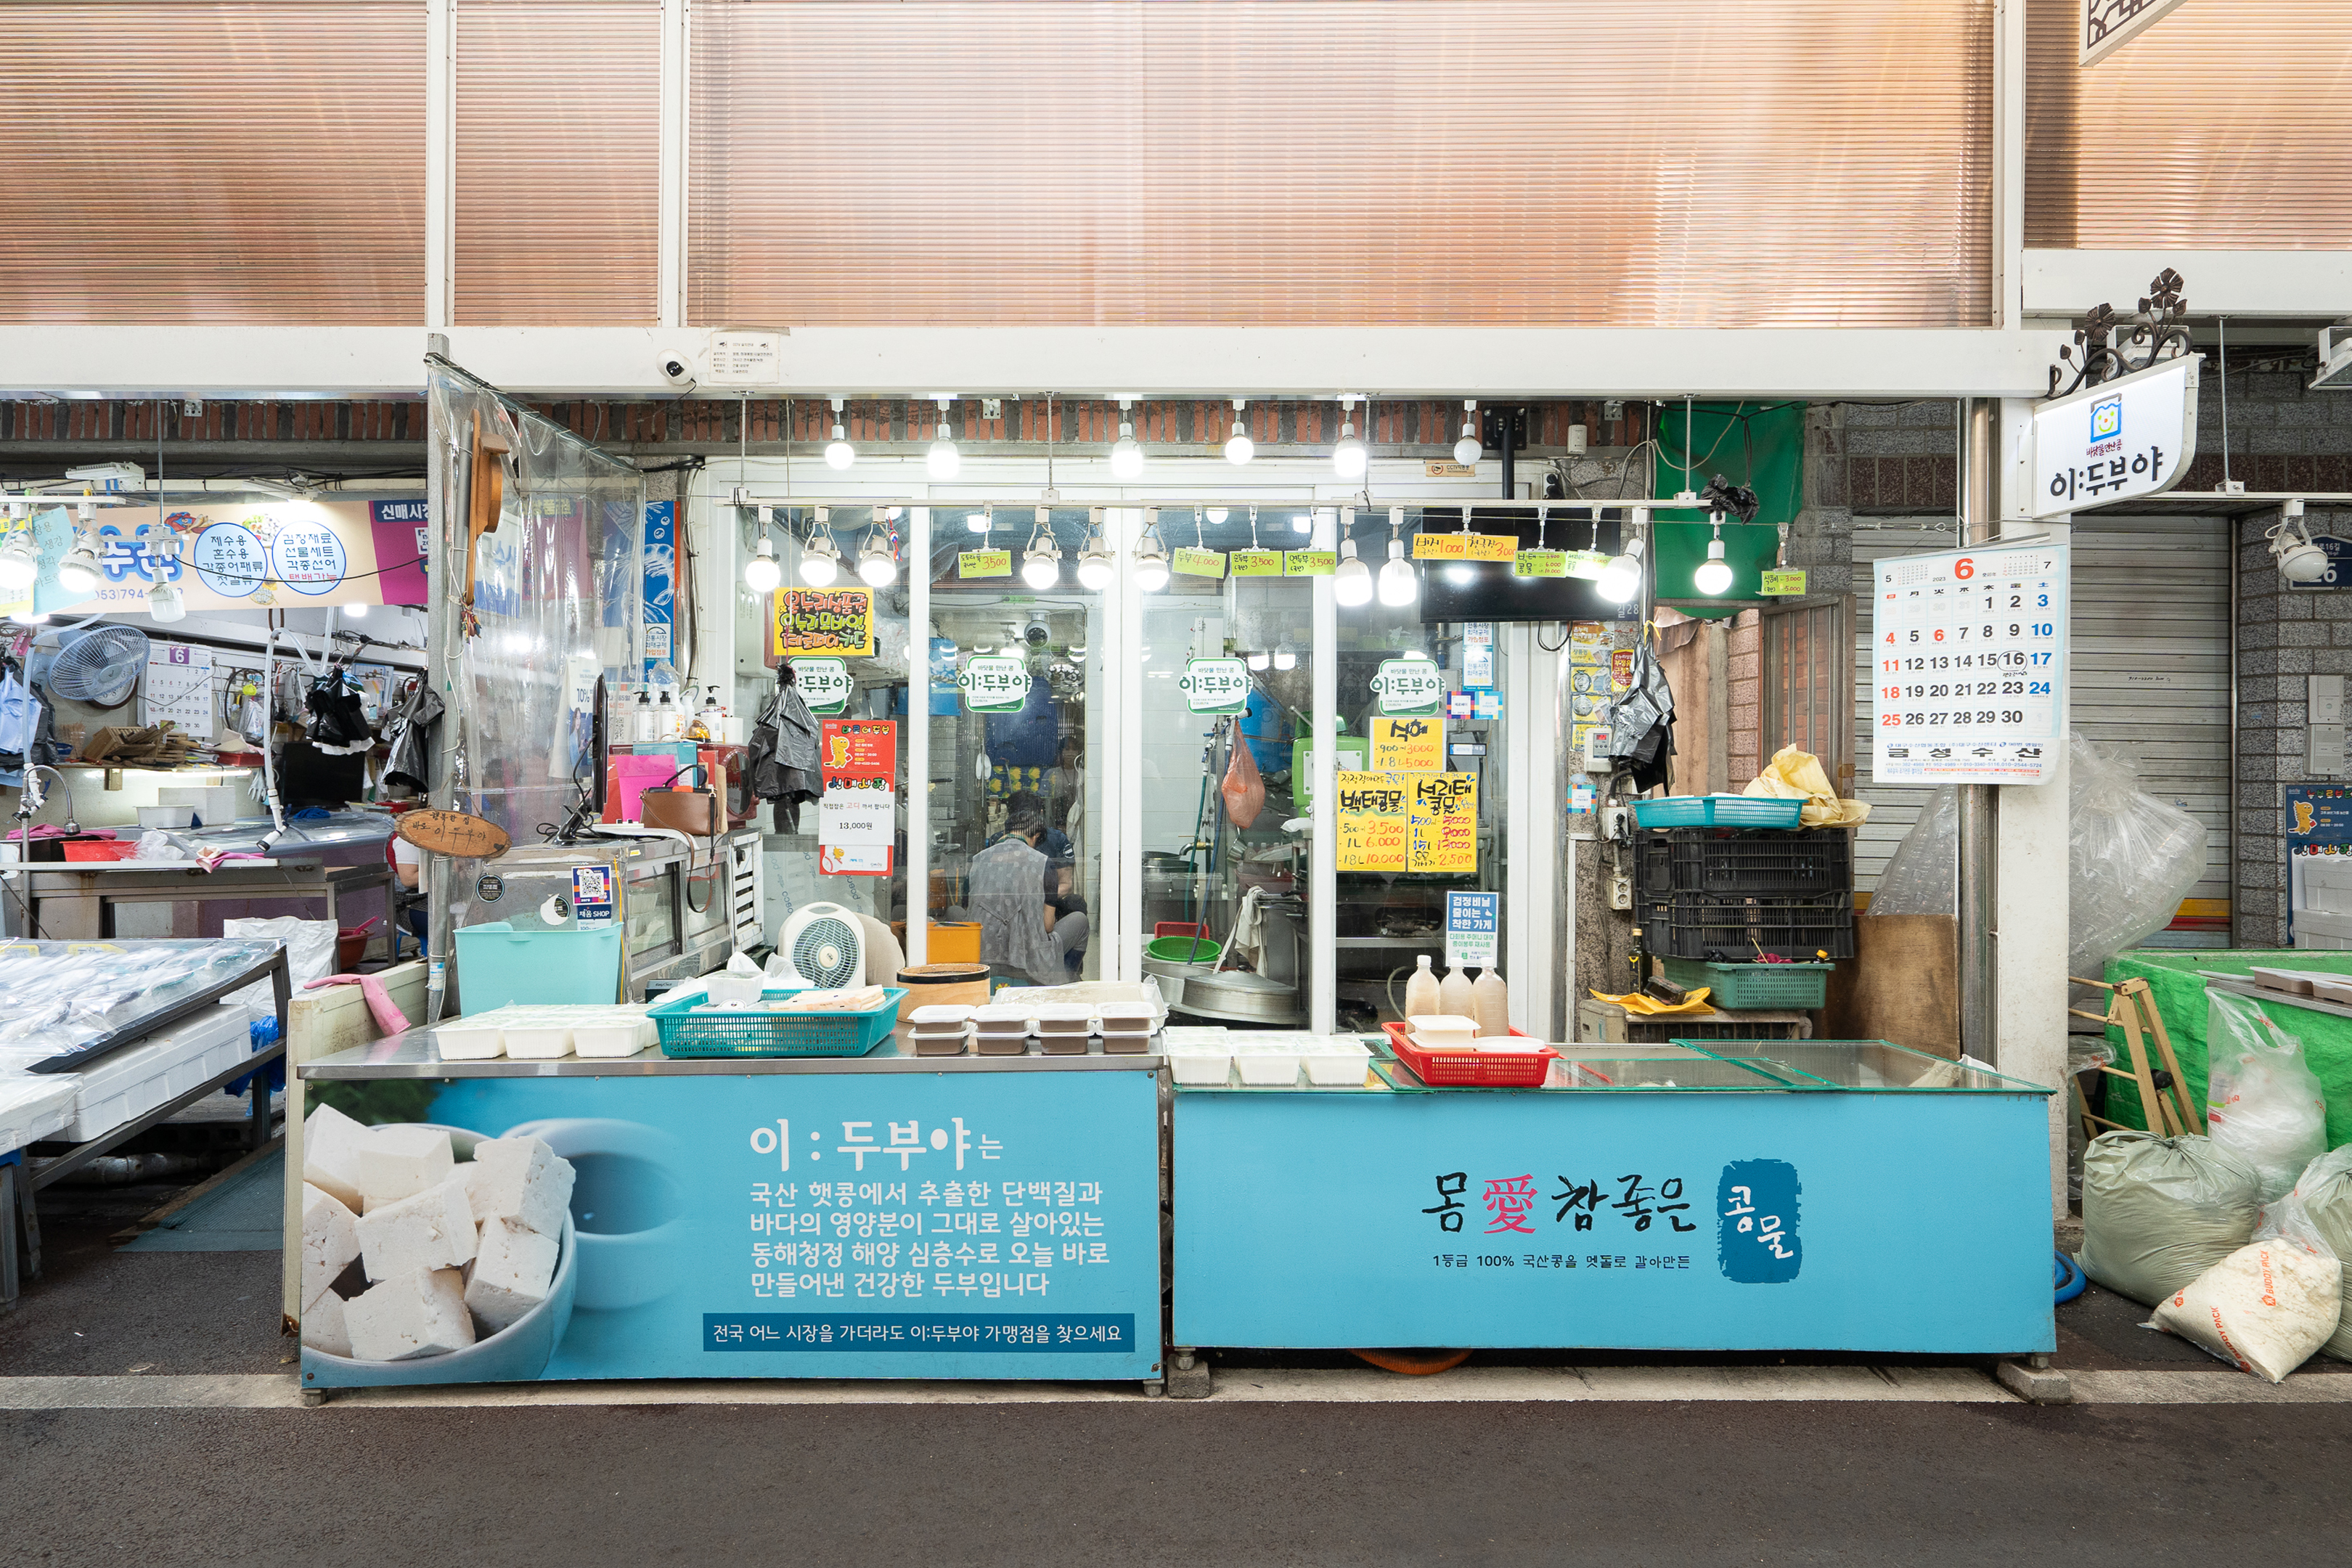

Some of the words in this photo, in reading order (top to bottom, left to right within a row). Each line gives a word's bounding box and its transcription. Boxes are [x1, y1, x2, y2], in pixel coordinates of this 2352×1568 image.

[2050, 446, 2163, 500] 이:두부야
[211, 536, 247, 547] 제수용
[283, 533, 332, 544] 김장재료
[213, 549, 249, 559] 혼수용
[285, 546, 334, 558] 선물세트
[1178, 551, 1192, 562] 두부
[1193, 555, 1220, 566] 4.000
[203, 560, 264, 573] 각종어패류
[287, 560, 336, 571] 각종선어
[1250, 556, 1274, 568] 3.500
[1289, 555, 1309, 564] 연두부
[1310, 557, 1334, 568] 3.500
[1954, 558, 1974, 579] 6
[289, 573, 338, 583] 택배가능
[784, 591, 868, 614] 온누리상품권
[1985, 597, 1993, 608] 1
[2010, 595, 2021, 608] 2
[2038, 595, 2049, 607] 3
[1885, 632, 1895, 644] 4
[1909, 630, 1919, 642] 5
[1934, 629, 1944, 641] 6
[1959, 627, 1969, 639] 7
[1983, 626, 1993, 637] 8
[2009, 624, 2020, 636] 9
[2031, 624, 2053, 636] 10
[176, 649, 184, 663] 6
[1883, 660, 1899, 671] 11
[1906, 658, 1924, 670] 12
[1930, 657, 1948, 669] 13
[1954, 656, 1972, 667] 14
[1978, 653, 1996, 666] 15
[2004, 653, 2025, 665] 16
[2030, 653, 2051, 665] 17
[799, 675, 852, 693] :두부야
[958, 673, 1030, 692] 이:두부야
[1179, 676, 1251, 693] 이:두부야
[1371, 677, 1445, 695] 이:두부야
[1882, 687, 1900, 698] 18
[1906, 685, 1924, 697] 19
[1930, 685, 1948, 697] 20
[1955, 684, 1971, 695] 21
[1977, 682, 1996, 695] 22
[2002, 682, 2023, 694] 23
[2029, 682, 2051, 694] 24
[1882, 714, 1900, 726] 25
[1906, 713, 1924, 724] 26
[1930, 713, 1948, 724] 27
[1953, 712, 1972, 724] 28
[1977, 711, 1996, 723] 29
[2001, 711, 2022, 723] 30
[828, 777, 886, 791] 신매시장
[1418, 779, 1471, 798] 서리태
[1340, 789, 1402, 813] 백태콩물
[1427, 796, 1455, 815] 콩물
[1367, 820, 1404, 835] 3.500
[1366, 836, 1400, 848] 6.000
[2294, 843, 2352, 856] 신매시장
[1366, 854, 1404, 865] 10.000
[1439, 854, 1472, 866] 2.500
[1453, 897, 1490, 907] 검정비닐
[1453, 907, 1481, 918] 줄이는
[1453, 919, 1471, 929] 착한
[1474, 920, 1492, 929] 가게
[749, 1118, 791, 1172] 이
[749, 1181, 798, 1208] 국산
[809, 1180, 908, 1208] 햇콩에서
[918, 1180, 992, 1208] 추출한
[1002, 1181, 1103, 1207] 단백질과
[1421, 1171, 1468, 1234] 몸
[1482, 1172, 1538, 1234] 愛
[749, 1212, 822, 1238] 바다의
[830, 1212, 923, 1237] 영양분이
[931, 1212, 1002, 1236] 그대로
[1010, 1211, 1105, 1238] 살아있는
[1723, 1185, 1794, 1259] 콩물
[751, 1241, 844, 1269] 동해청정
[851, 1241, 901, 1267] 해양
[907, 1241, 1001, 1267] 심층수로
[1008, 1241, 1055, 1266] 오늘
[1062, 1241, 1111, 1266] 바로
[1433, 1254, 1469, 1269] 1등급
[1477, 1254, 1515, 1267] 100%
[1522, 1254, 1577, 1270] 국산콩을
[1586, 1254, 1628, 1270] 멧돌로
[1635, 1254, 1690, 1270] 갈아만든
[2260, 1249, 2271, 1267] PACK
[751, 1273, 845, 1298] 만들어낸
[854, 1271, 926, 1298] 건강한
[932, 1271, 1050, 1297] 두부입니다
[2262, 1269, 2274, 1294] BUDDY
[712, 1324, 745, 1344] 전국
[749, 1325, 781, 1342] 어느
[786, 1324, 835, 1344] 시장을
[838, 1324, 905, 1343] 가더라도
[910, 1324, 980, 1344] 이:두부야
[984, 1324, 1051, 1344] 가맹점을
[1055, 1324, 1122, 1344] 찾으세요
